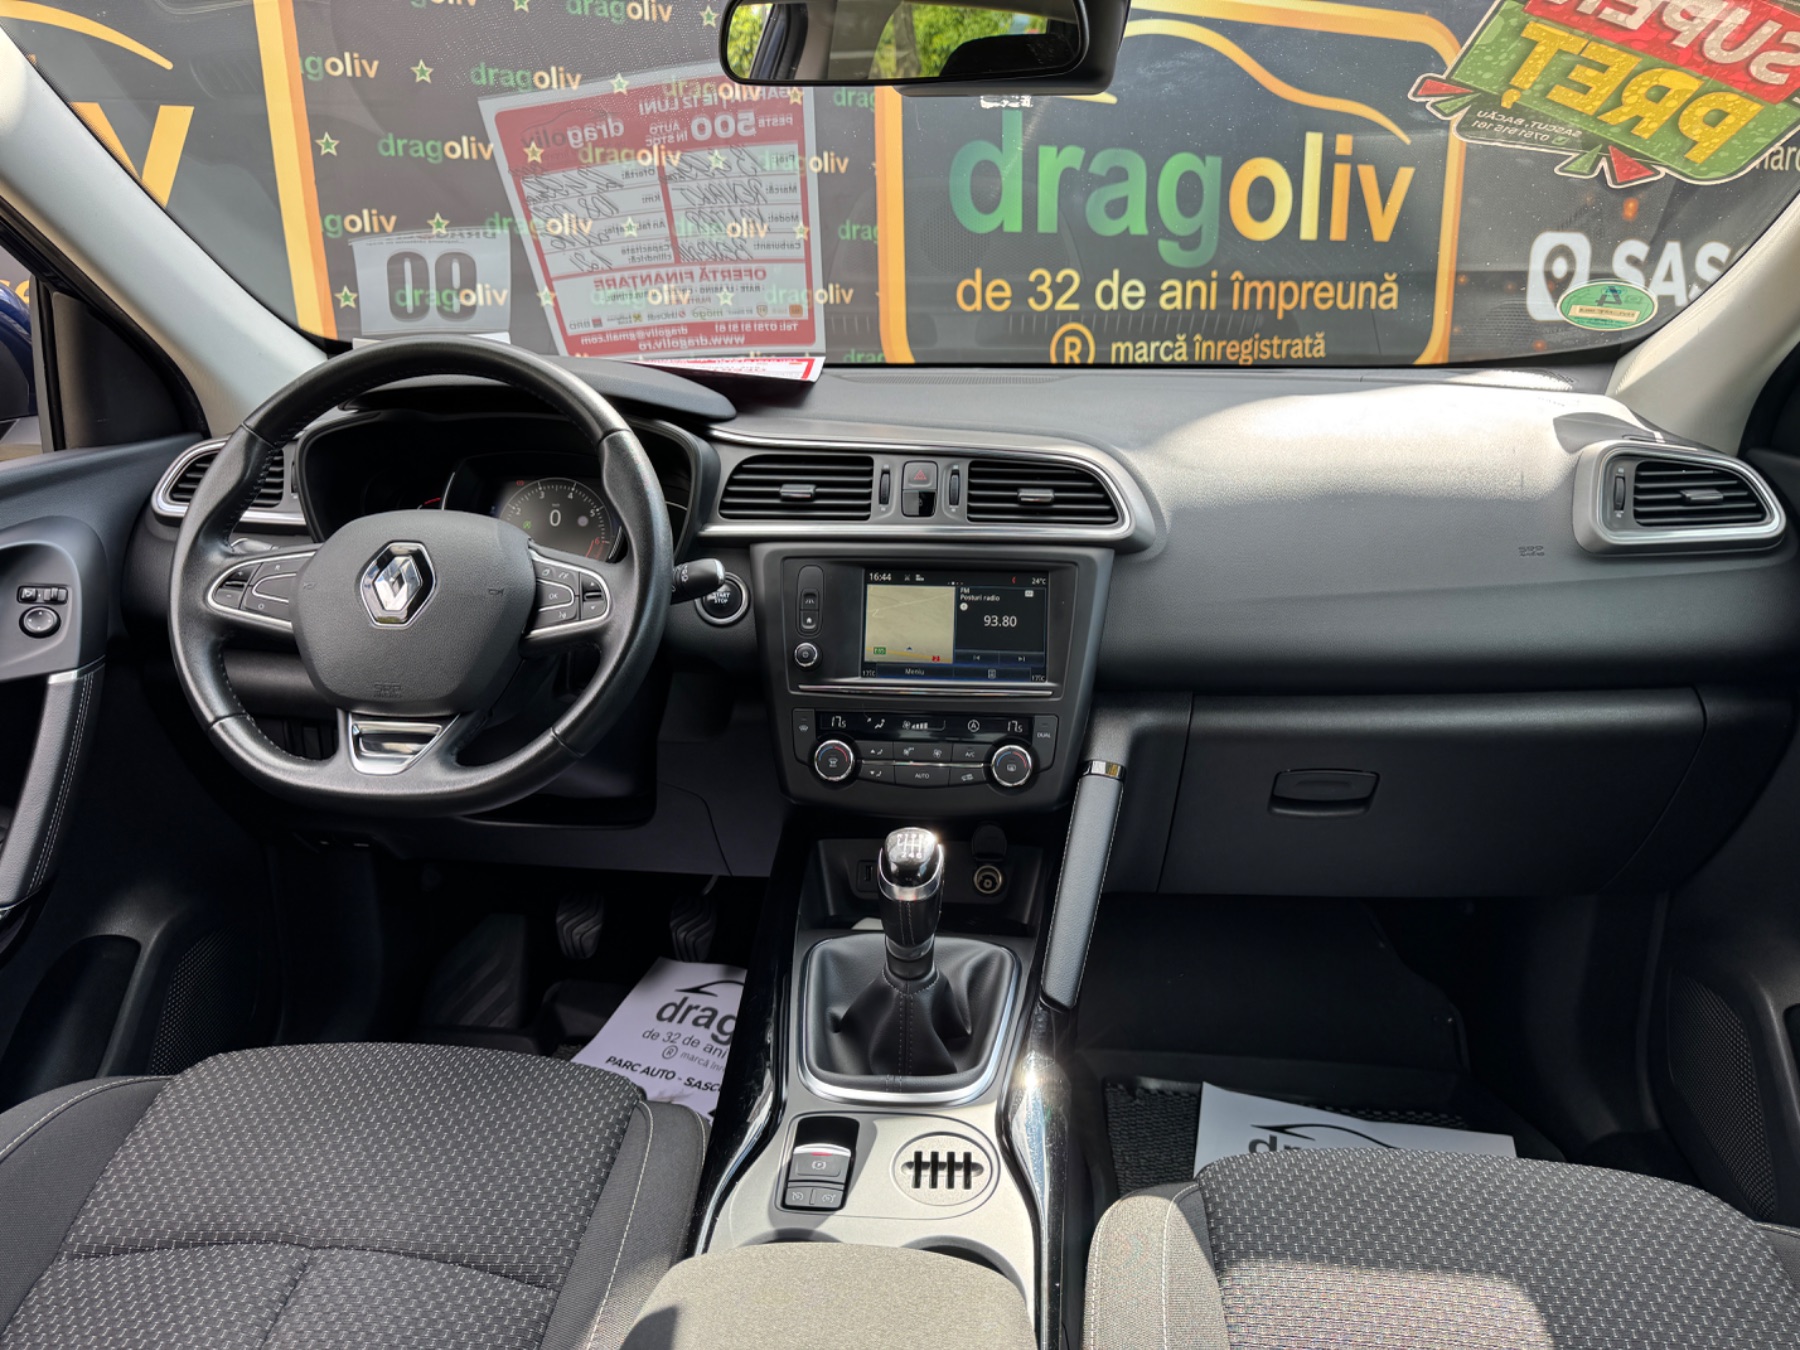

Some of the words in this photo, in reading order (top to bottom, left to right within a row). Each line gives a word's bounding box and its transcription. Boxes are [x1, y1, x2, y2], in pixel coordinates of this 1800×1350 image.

[301, 51, 379, 82] goliv
[470, 62, 582, 92] dragoliv
[377, 132, 493, 165] dragoliv
[577, 143, 681, 168] dragoliv
[949, 110, 1416, 269] dragoliv
[322, 208, 398, 238] goliv
[956, 268, 1012, 311] de
[1026, 268, 1080, 310] 32
[1095, 268, 1146, 310] de
[1159, 270, 1217, 310] ani
[1230, 271, 1399, 320] împreună
[1111, 334, 1187, 363] marcă
[1193, 331, 1326, 365] înregistrată
[869, 572, 892, 582] 16:44
[983, 614, 1018, 628] 93.80
[904, 667, 925, 676] Meniu
[914, 772, 930, 780] AUTO
[642, 1028, 660, 1041] de
[662, 1030, 682, 1044] 32
[682, 1034, 701, 1048] de
[703, 1043, 728, 1060] ani
[605, 1055, 642, 1073] PARC
[639, 1065, 677, 1081] AUTO
[683, 1076, 721, 1093] SASC
